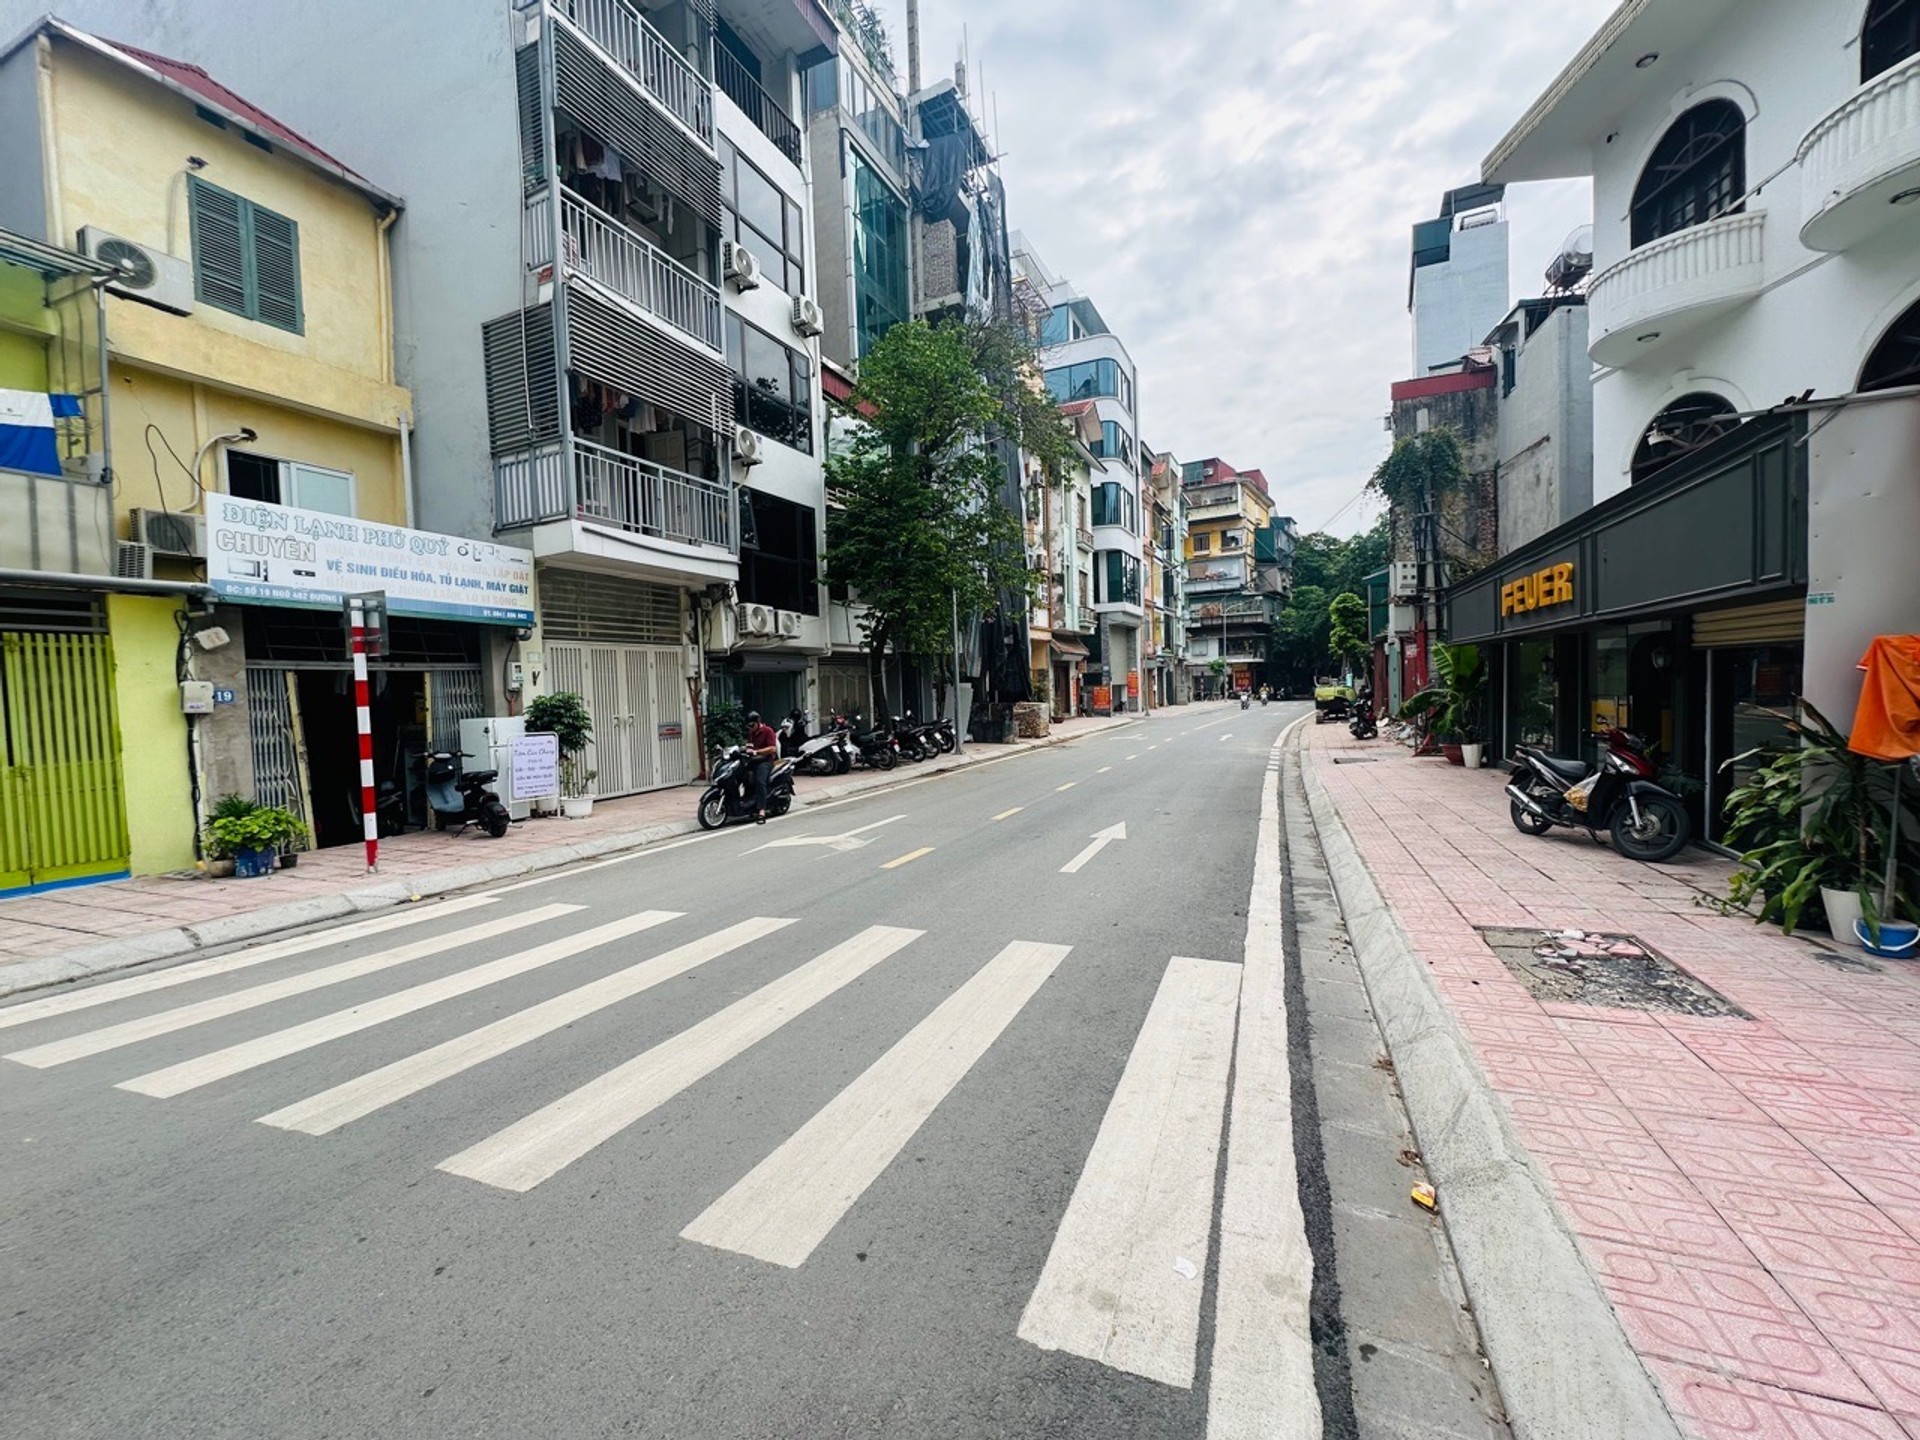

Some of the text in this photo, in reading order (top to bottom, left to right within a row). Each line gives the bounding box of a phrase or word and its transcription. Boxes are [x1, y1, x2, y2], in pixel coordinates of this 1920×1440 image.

[223, 502, 289, 532] ĐIỆN
[294, 512, 358, 543] LẠNH
[216, 528, 317, 564] CHUYÊN
[326, 557, 343, 574] VỆ
[346, 562, 377, 577] SINH
[1501, 562, 1574, 618] FEUER
[215, 691, 232, 702] 19
